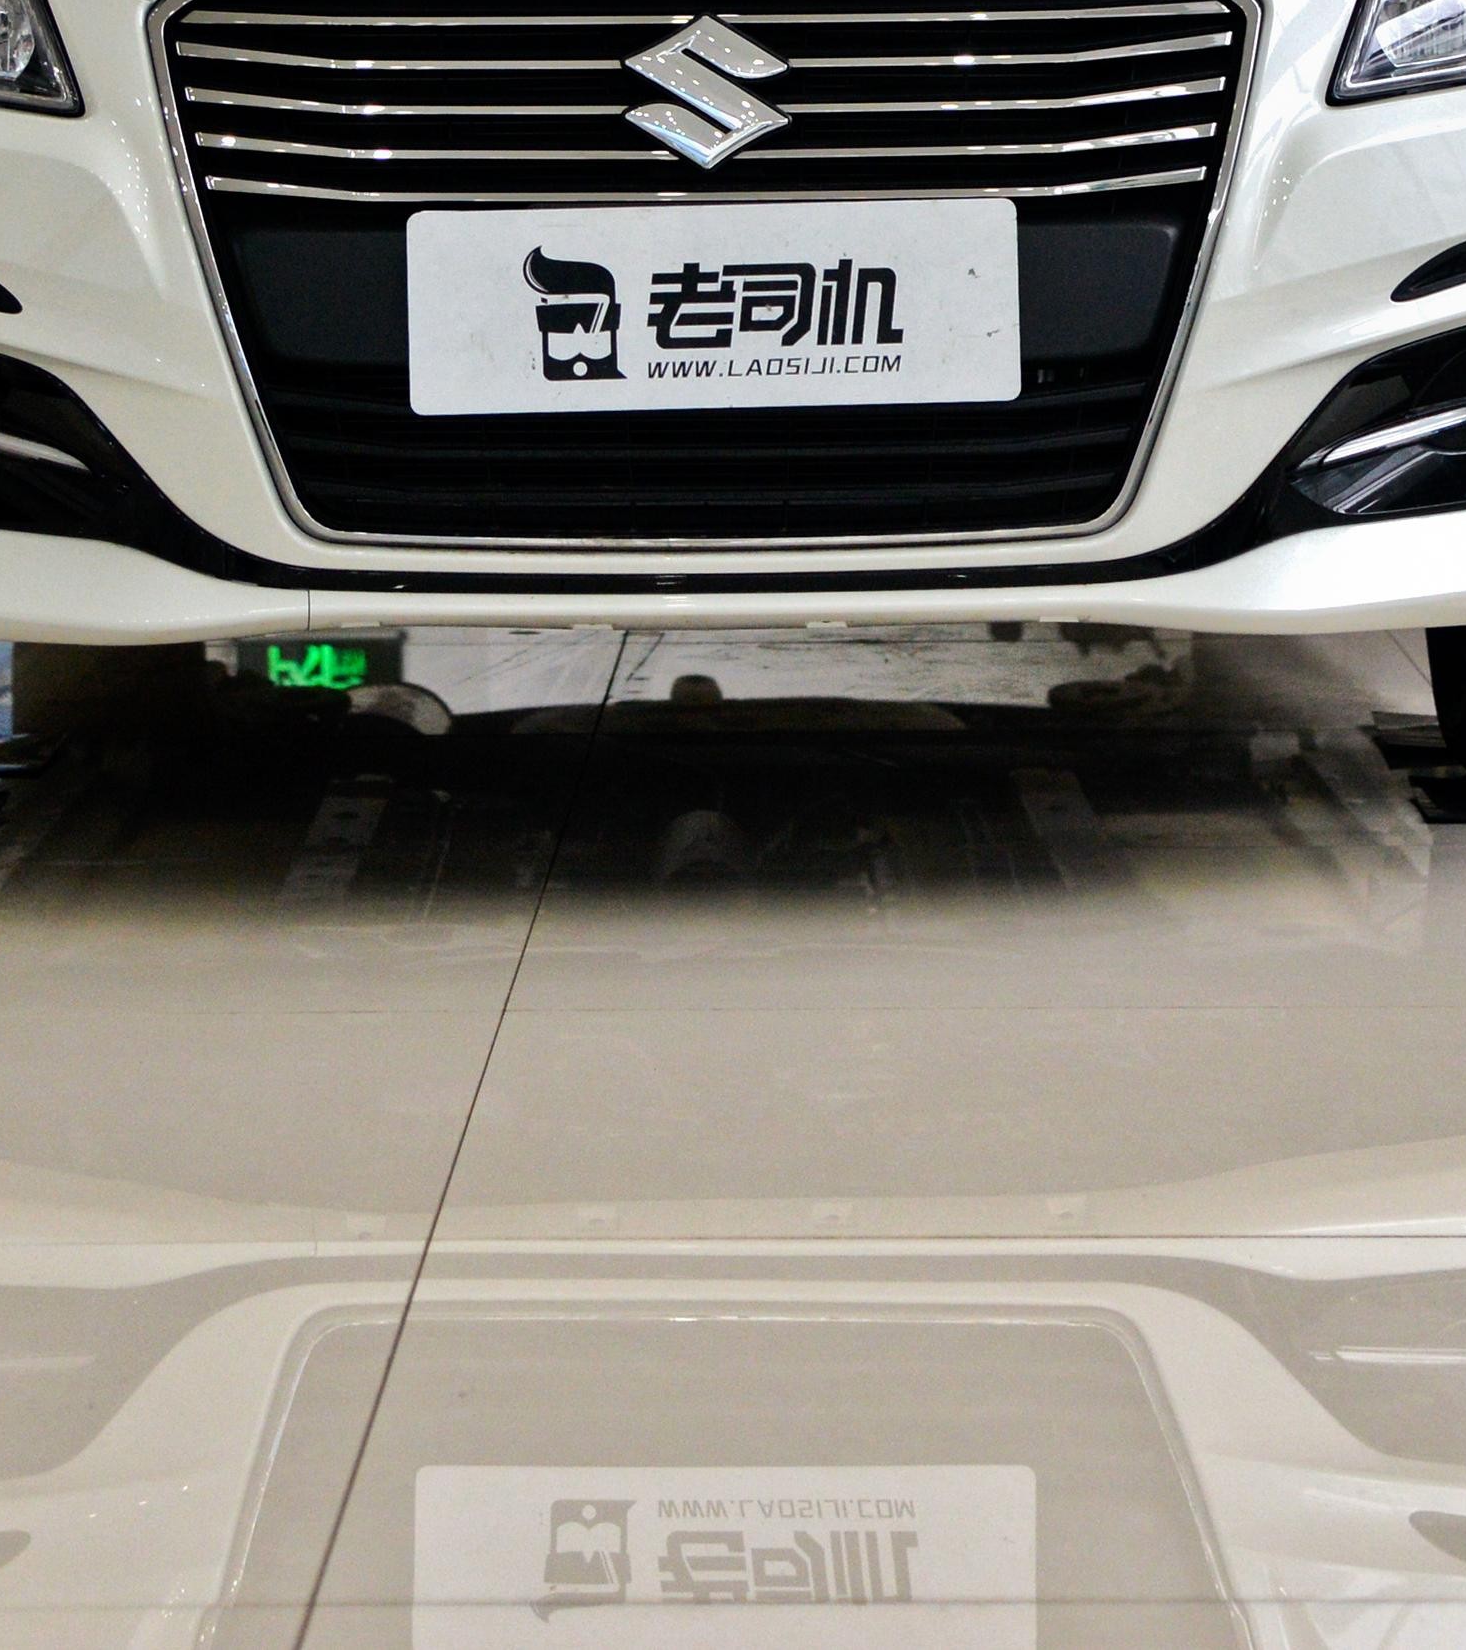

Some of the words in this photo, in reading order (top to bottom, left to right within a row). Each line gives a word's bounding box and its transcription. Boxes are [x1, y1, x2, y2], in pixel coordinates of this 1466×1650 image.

[647, 258, 904, 350] 老司机
[647, 353, 902, 379] WWW.LAOSIJI.COM
